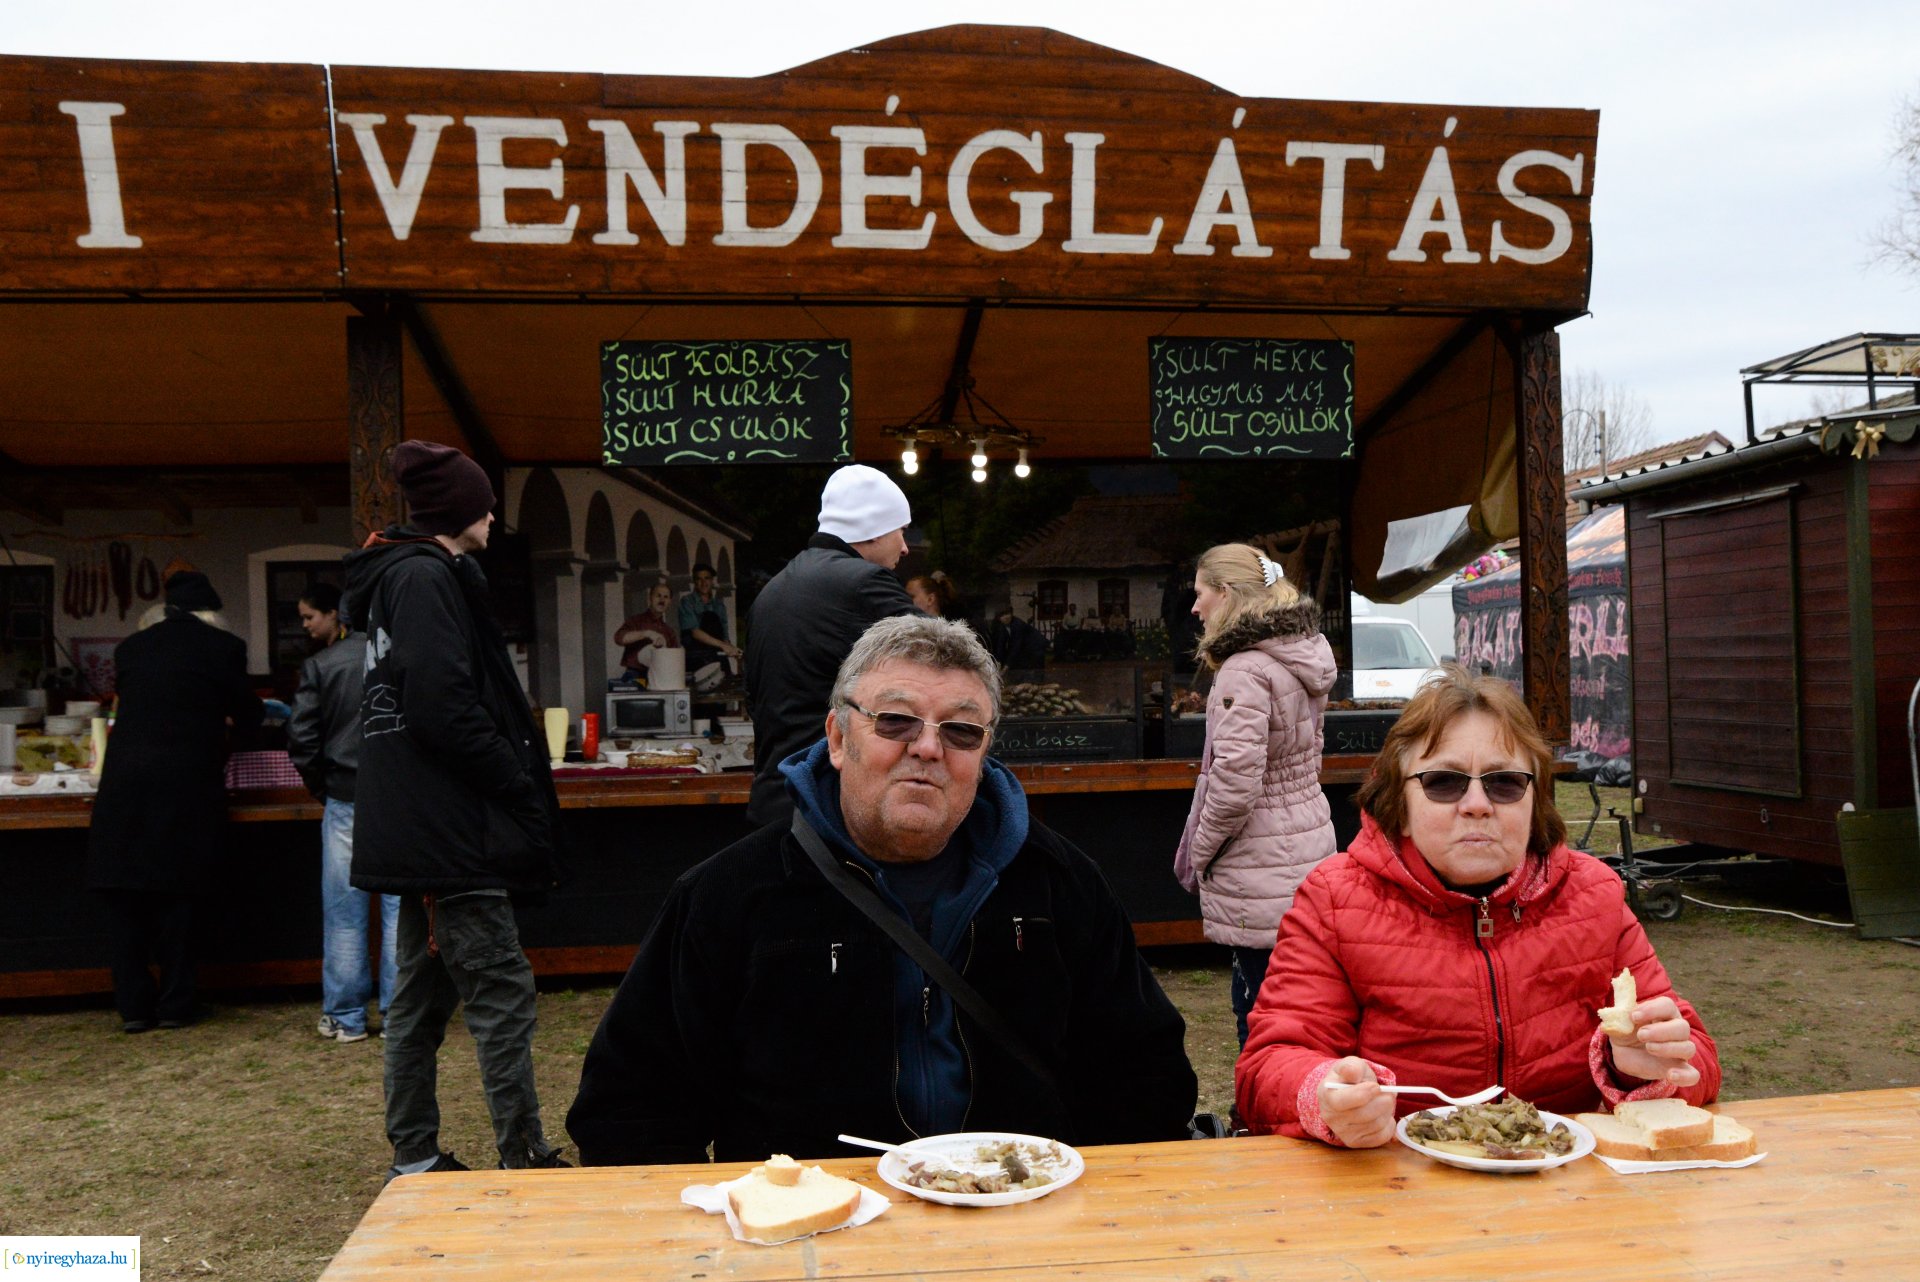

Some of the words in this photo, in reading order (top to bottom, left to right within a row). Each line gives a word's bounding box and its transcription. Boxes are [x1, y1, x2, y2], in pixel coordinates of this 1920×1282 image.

[58, 101, 143, 249] I
[337, 94, 1584, 265] VENDÉGLÁTÁS
[615, 351, 677, 384] SÜLT
[1254, 348, 1328, 373] HEKK
[693, 379, 806, 407] HURKA
[614, 416, 682, 451] SÜLT
[1169, 407, 1243, 442] SÜLT
[1247, 407, 1340, 436] CSÜLÖK
